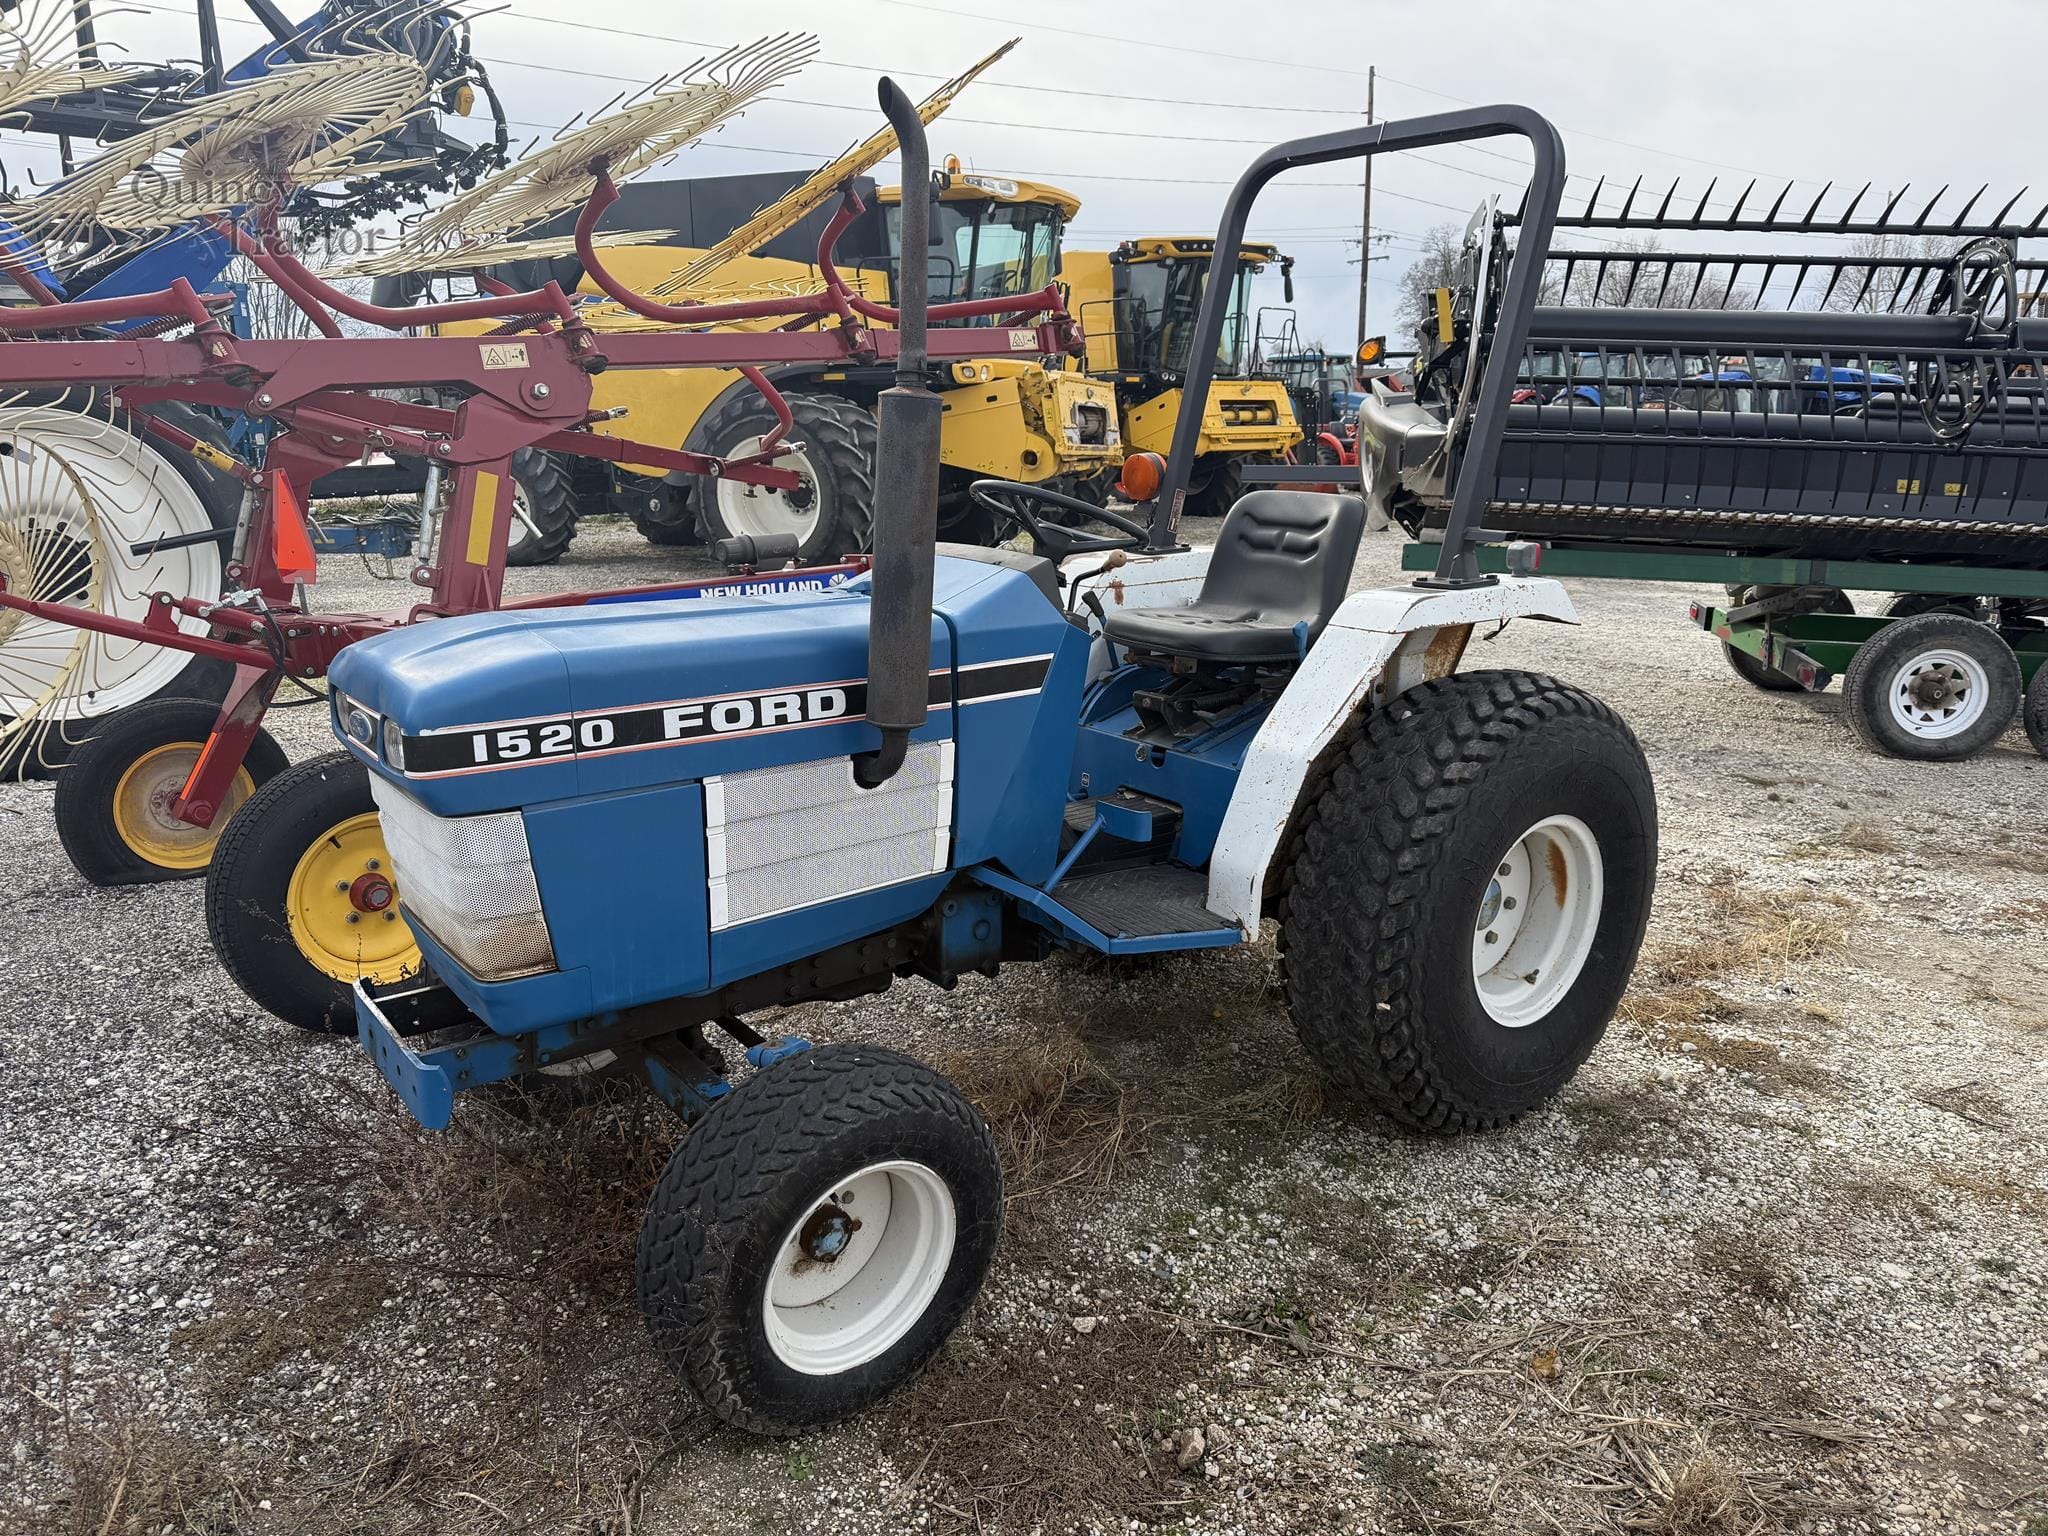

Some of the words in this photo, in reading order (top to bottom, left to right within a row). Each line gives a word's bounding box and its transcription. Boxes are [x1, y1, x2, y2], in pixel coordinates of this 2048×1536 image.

[700, 585, 742, 598] NEW
[745, 580, 823, 597] HOLLAND
[473, 719, 614, 762] 1520
[662, 688, 847, 739] FORD
